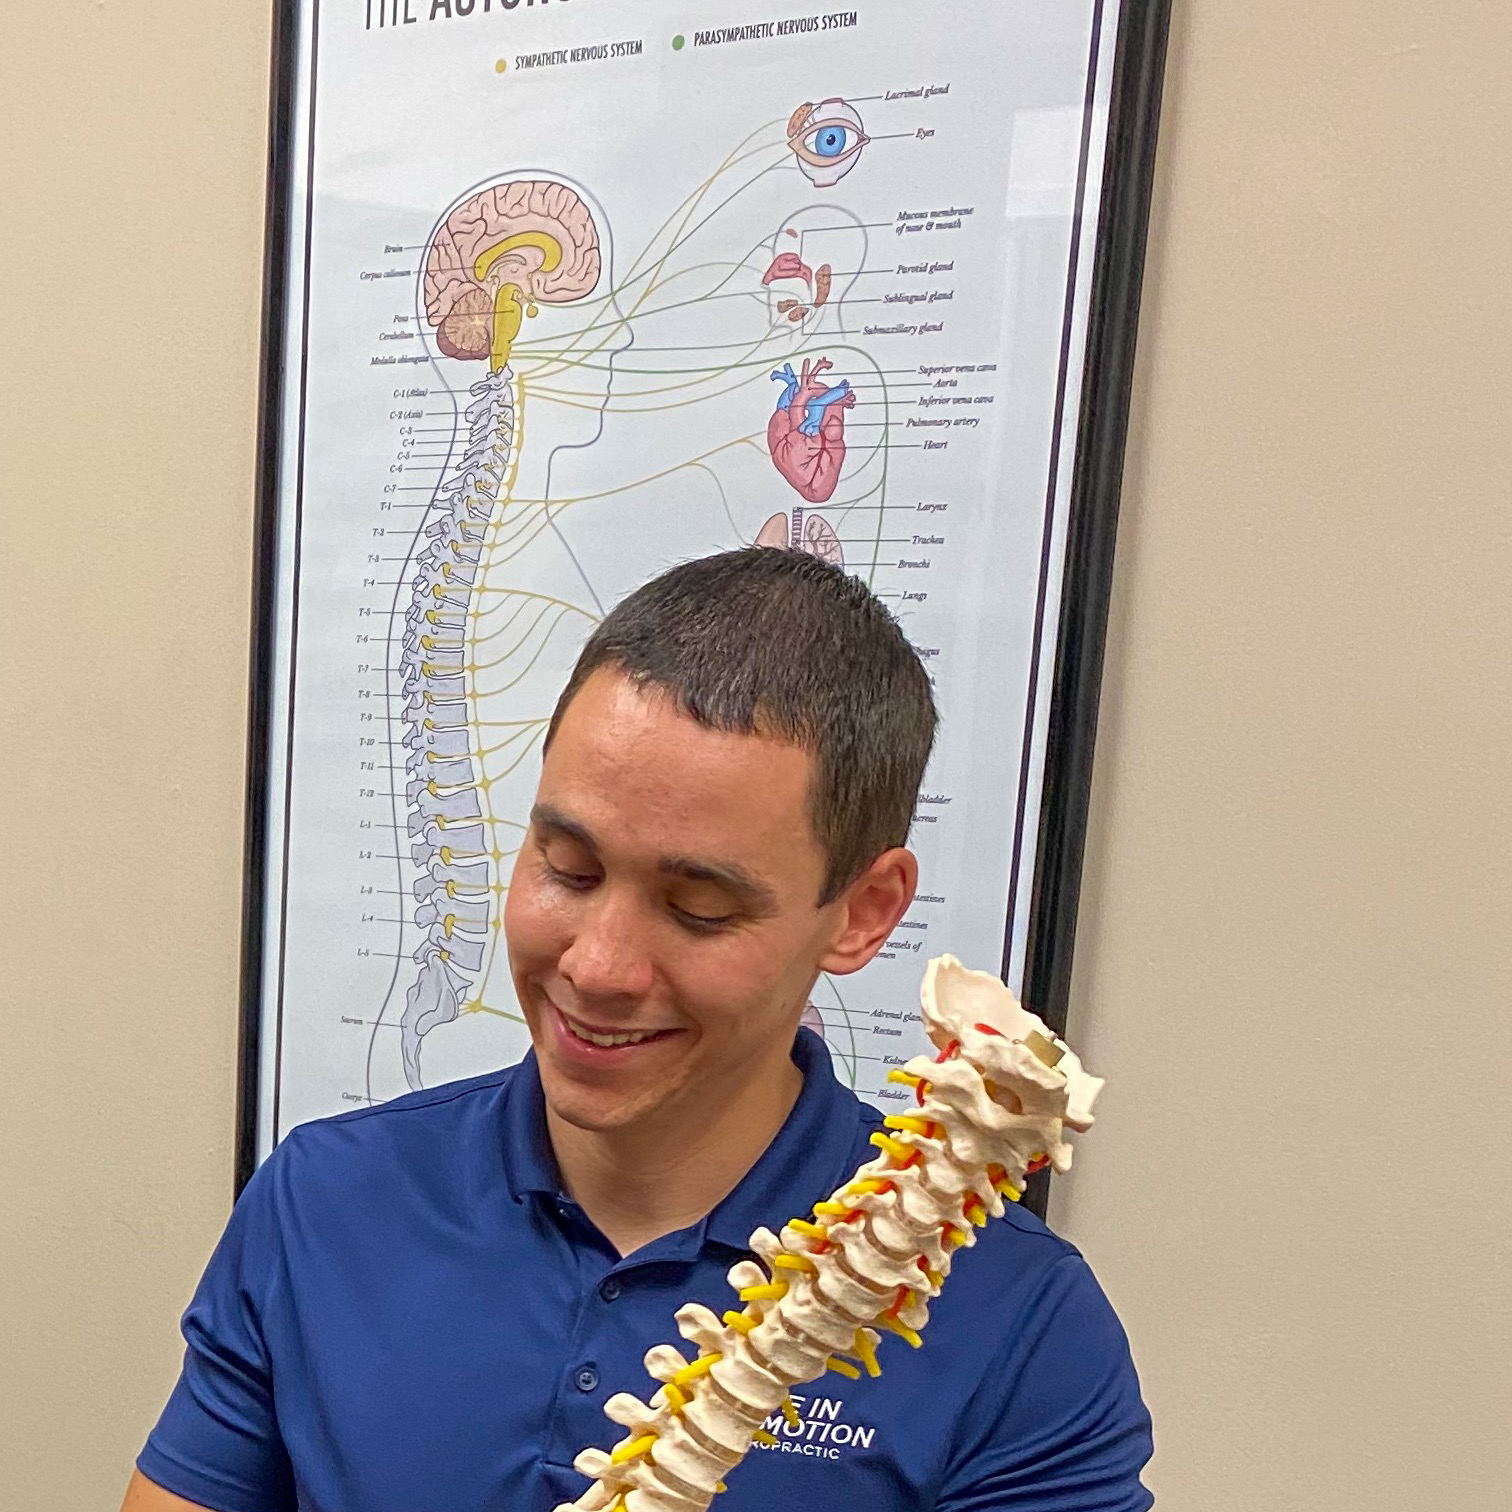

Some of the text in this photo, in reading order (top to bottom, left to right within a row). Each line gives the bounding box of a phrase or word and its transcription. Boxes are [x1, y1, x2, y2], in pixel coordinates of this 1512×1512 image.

[694, 10, 858, 48] PARASYMPATHETIC NERVOUS SYSTEM
[515, 39, 643, 71] SYMPATHETIC NERVOUS SYSTEM
[896, 261, 929, 275] Parotid
[952, 416, 981, 429] artery
[402, 438, 415, 448] C-4
[923, 439, 949, 450] Heart
[389, 463, 403, 474] C-6
[383, 483, 397, 493] C-7
[380, 501, 392, 512] T-1
[916, 501, 949, 514] Larynx
[901, 589, 928, 603] Lungs
[869, 1008, 924, 1023] Adrenal glan
[808, 1398, 843, 1421] IN
[759, 1415, 876, 1448] MOTION
